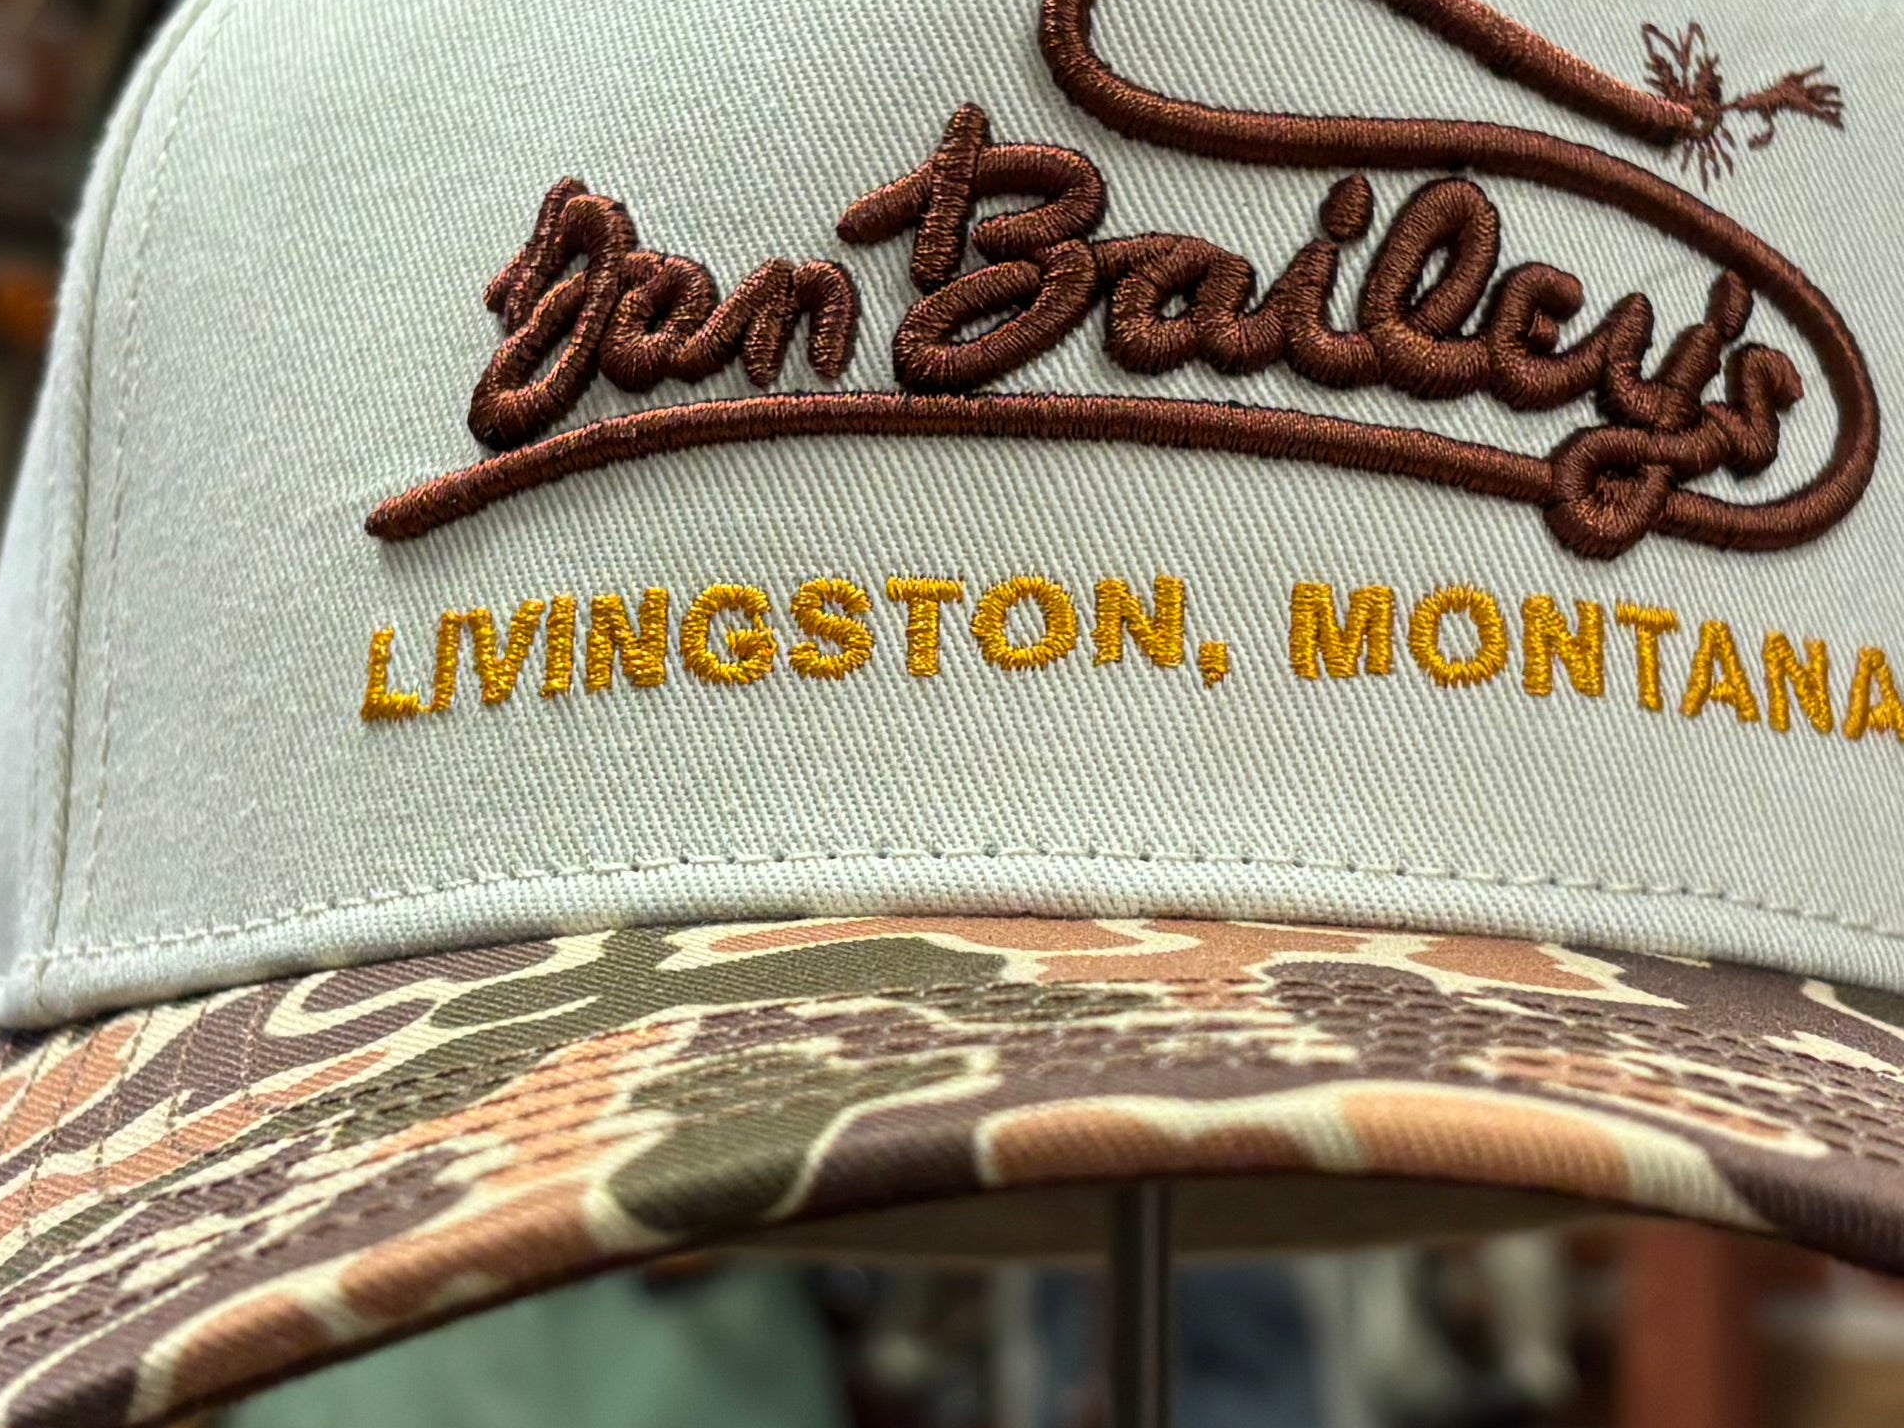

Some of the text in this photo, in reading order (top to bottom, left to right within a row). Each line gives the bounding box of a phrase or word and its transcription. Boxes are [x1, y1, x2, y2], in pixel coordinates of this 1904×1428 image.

[467, 100, 1805, 562] Dan Bailey's
[360, 574, 1231, 726] LIVINGSTON,
